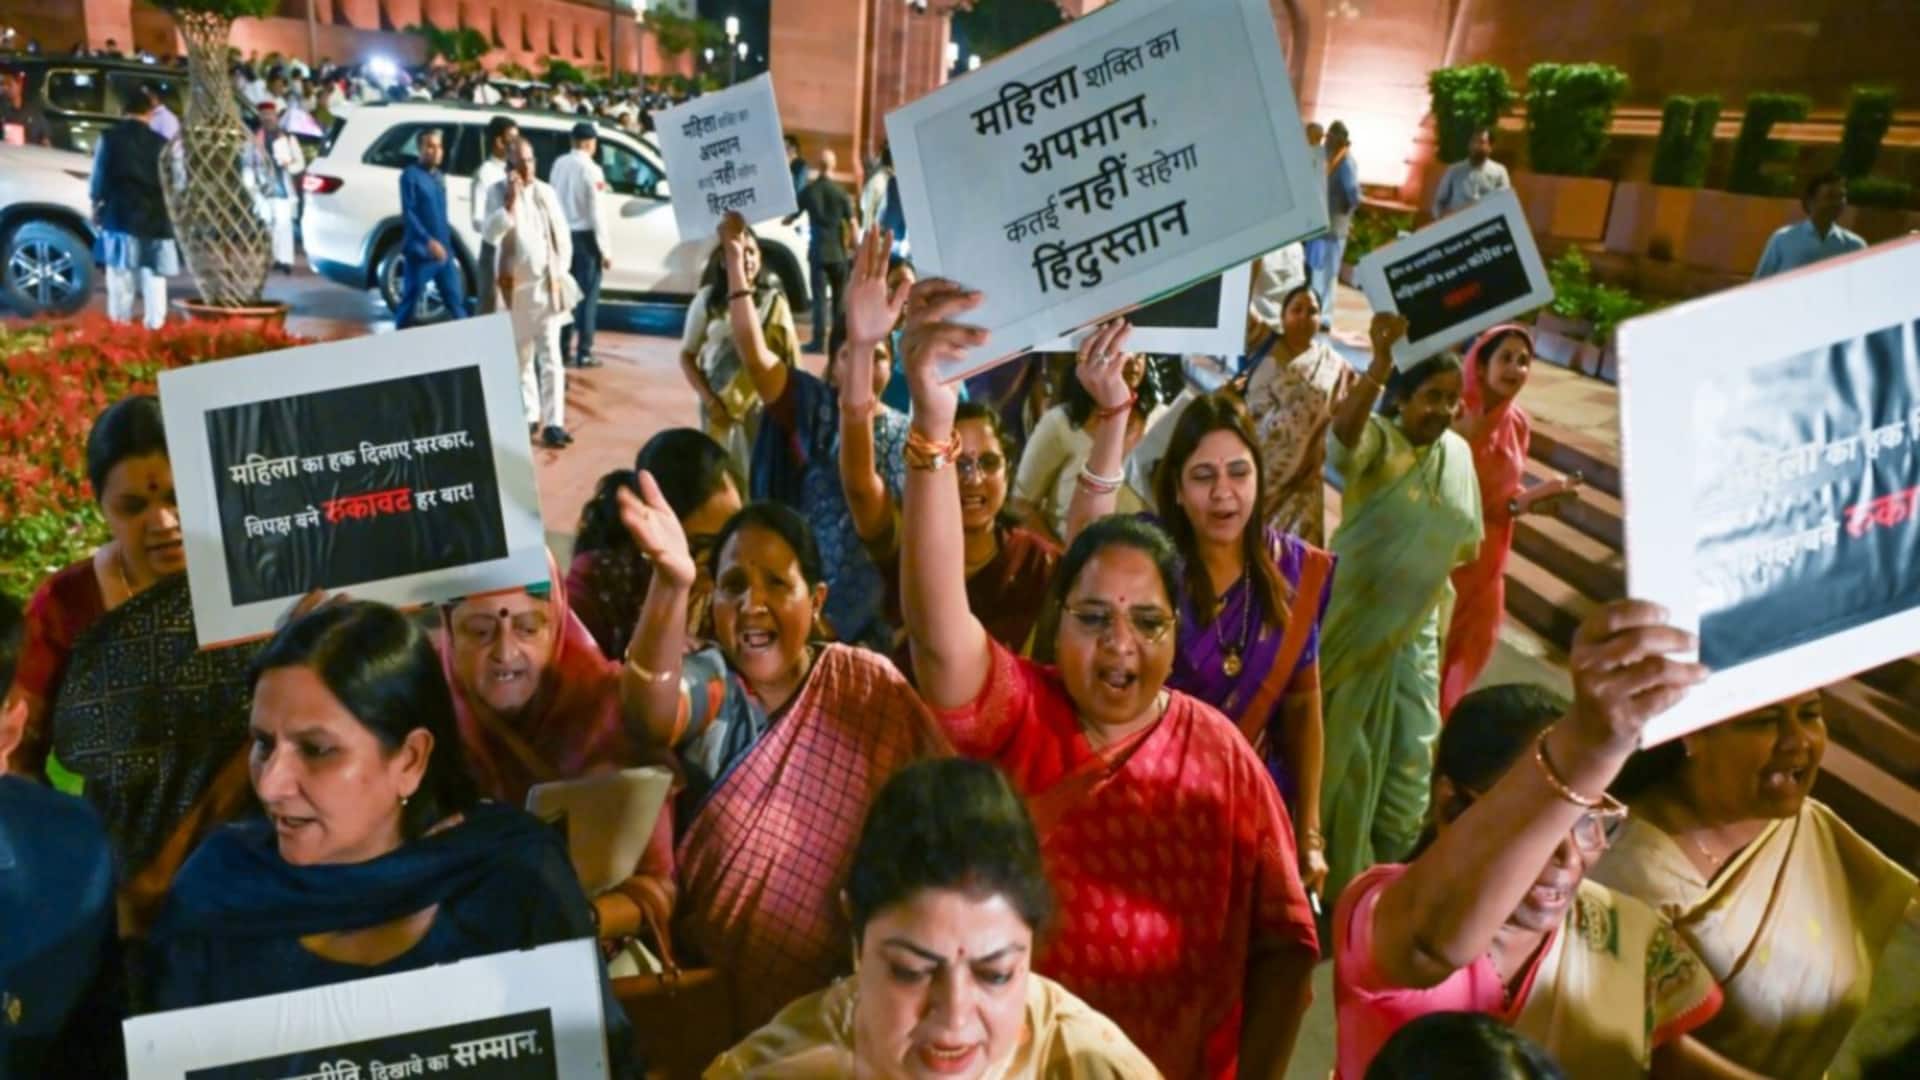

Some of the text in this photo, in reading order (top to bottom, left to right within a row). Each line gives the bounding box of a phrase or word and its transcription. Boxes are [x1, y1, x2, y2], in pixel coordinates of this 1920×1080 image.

[971, 28, 1181, 136] महिला शक्ति का
[1003, 143, 1198, 243] कतई नहीं सहेगा
[1031, 200, 1189, 293] हिंदुस्तान
[229, 454, 299, 486] महिला
[302, 455, 324, 475] का
[327, 450, 356, 473] हक
[359, 440, 412, 466] दिलाए
[244, 482, 474, 539] विपक्ष बने रुकावट हर बार!
[370, 1054, 423, 1080] दिखावे
[427, 1055, 450, 1070] का
